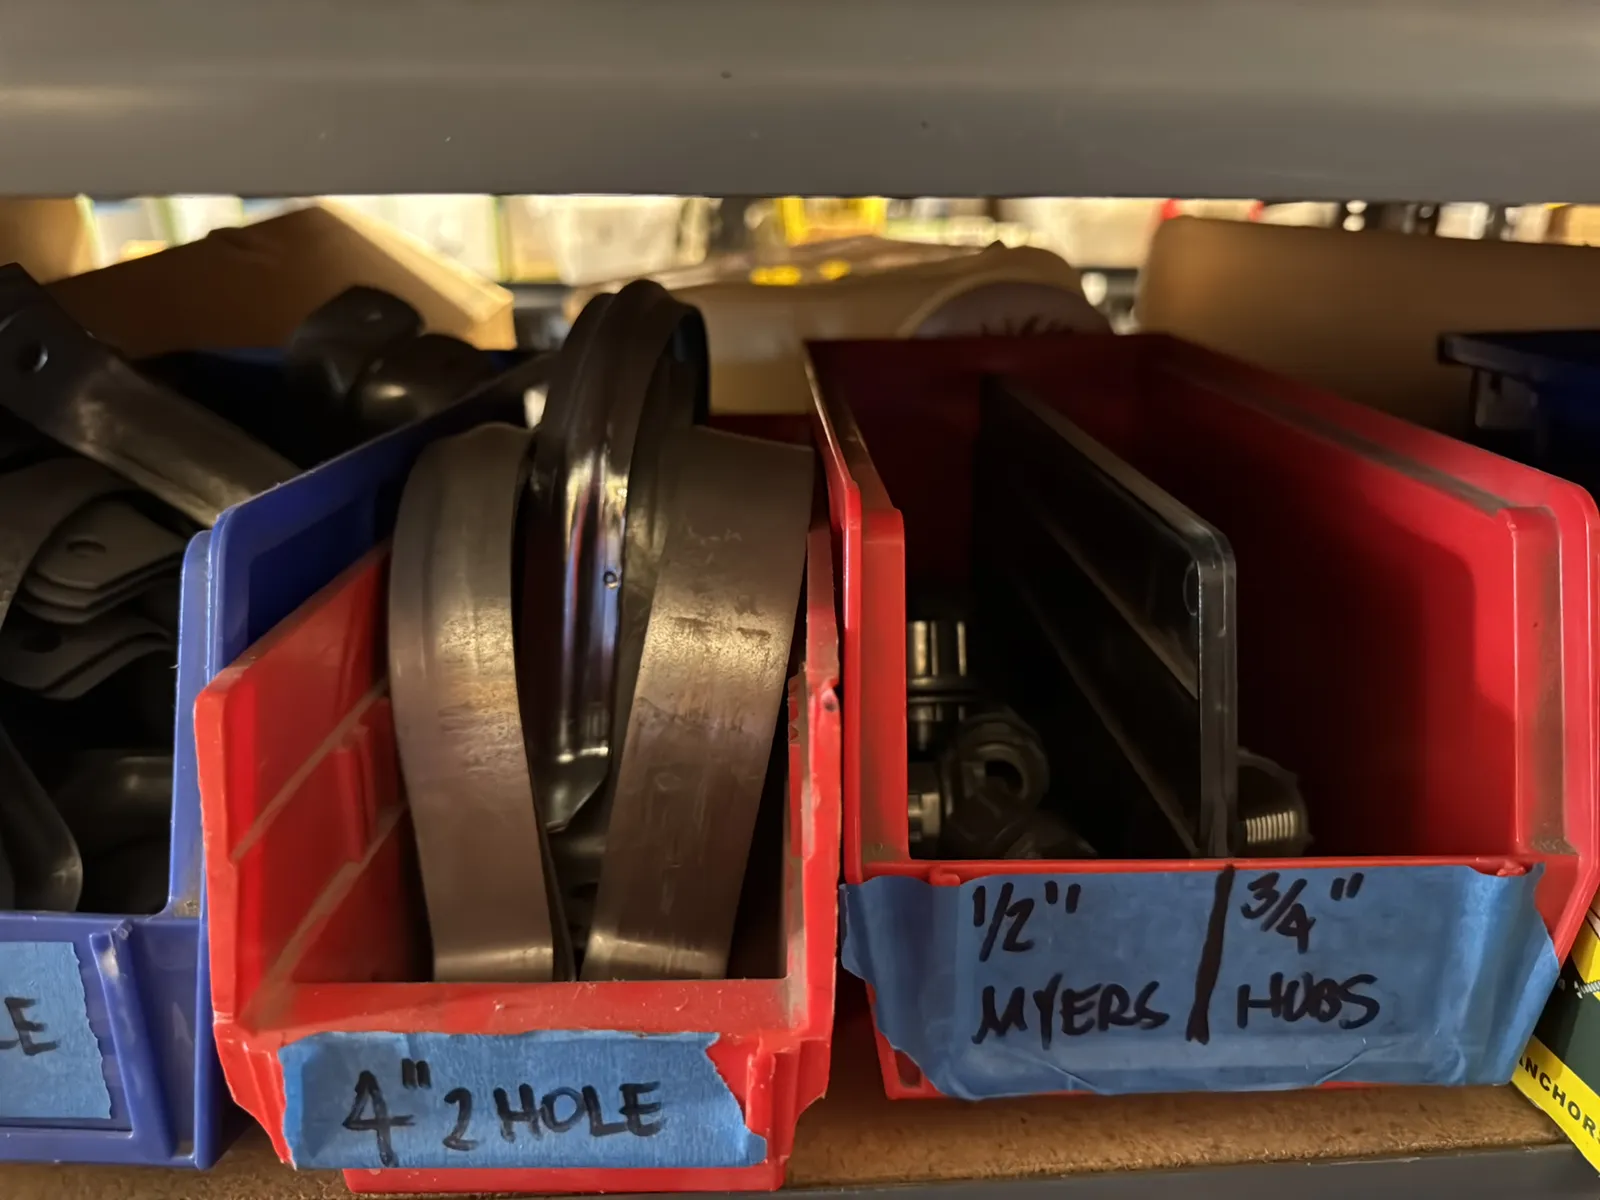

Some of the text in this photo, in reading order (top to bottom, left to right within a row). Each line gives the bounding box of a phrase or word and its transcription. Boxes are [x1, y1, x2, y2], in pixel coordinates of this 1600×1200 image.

[972, 872, 1364, 962] 1/2" 3/4"
[0, 996, 61, 1056] E
[971, 972, 1380, 1050] MYERS HUBS
[341, 1057, 667, 1168] 4" 2 HOLE
